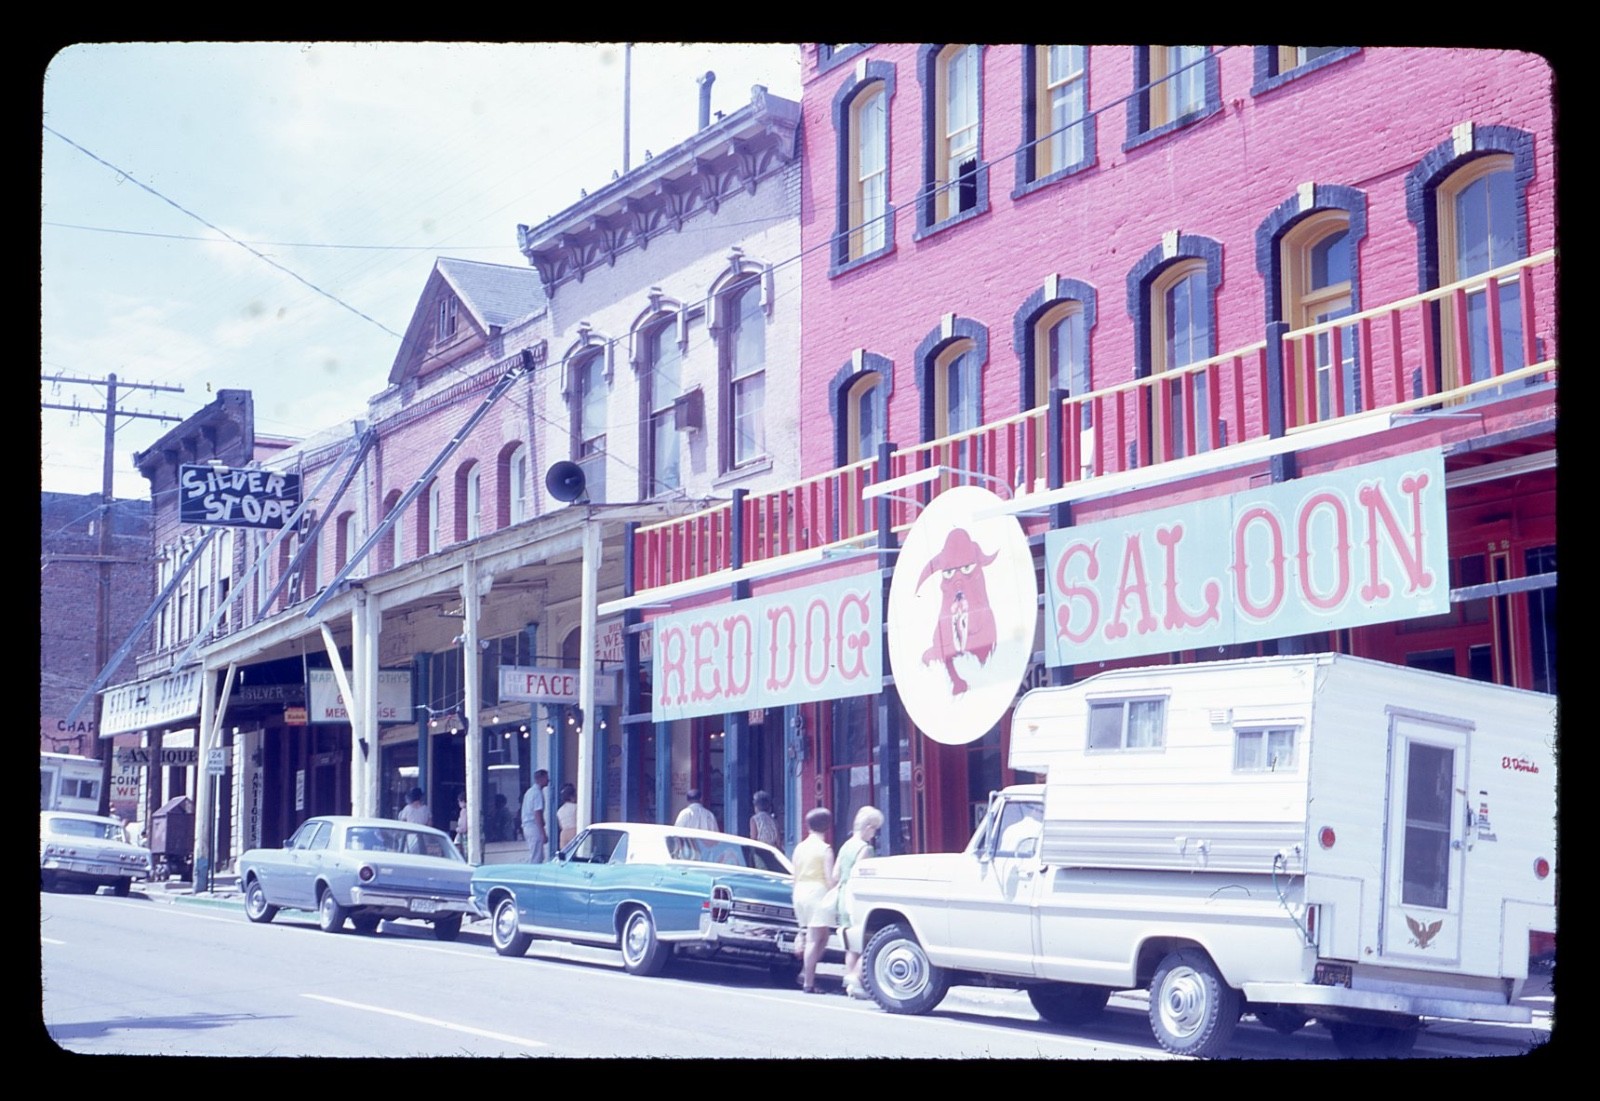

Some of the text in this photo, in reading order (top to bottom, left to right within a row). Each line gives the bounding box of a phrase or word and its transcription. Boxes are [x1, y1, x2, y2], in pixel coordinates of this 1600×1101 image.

[182, 469, 286, 499] SILVER
[203, 493, 295, 525] STOPE
[1056, 472, 1435, 645] SALOON
[659, 590, 871, 707] RED DOG
[526, 673, 574, 696] FACE
